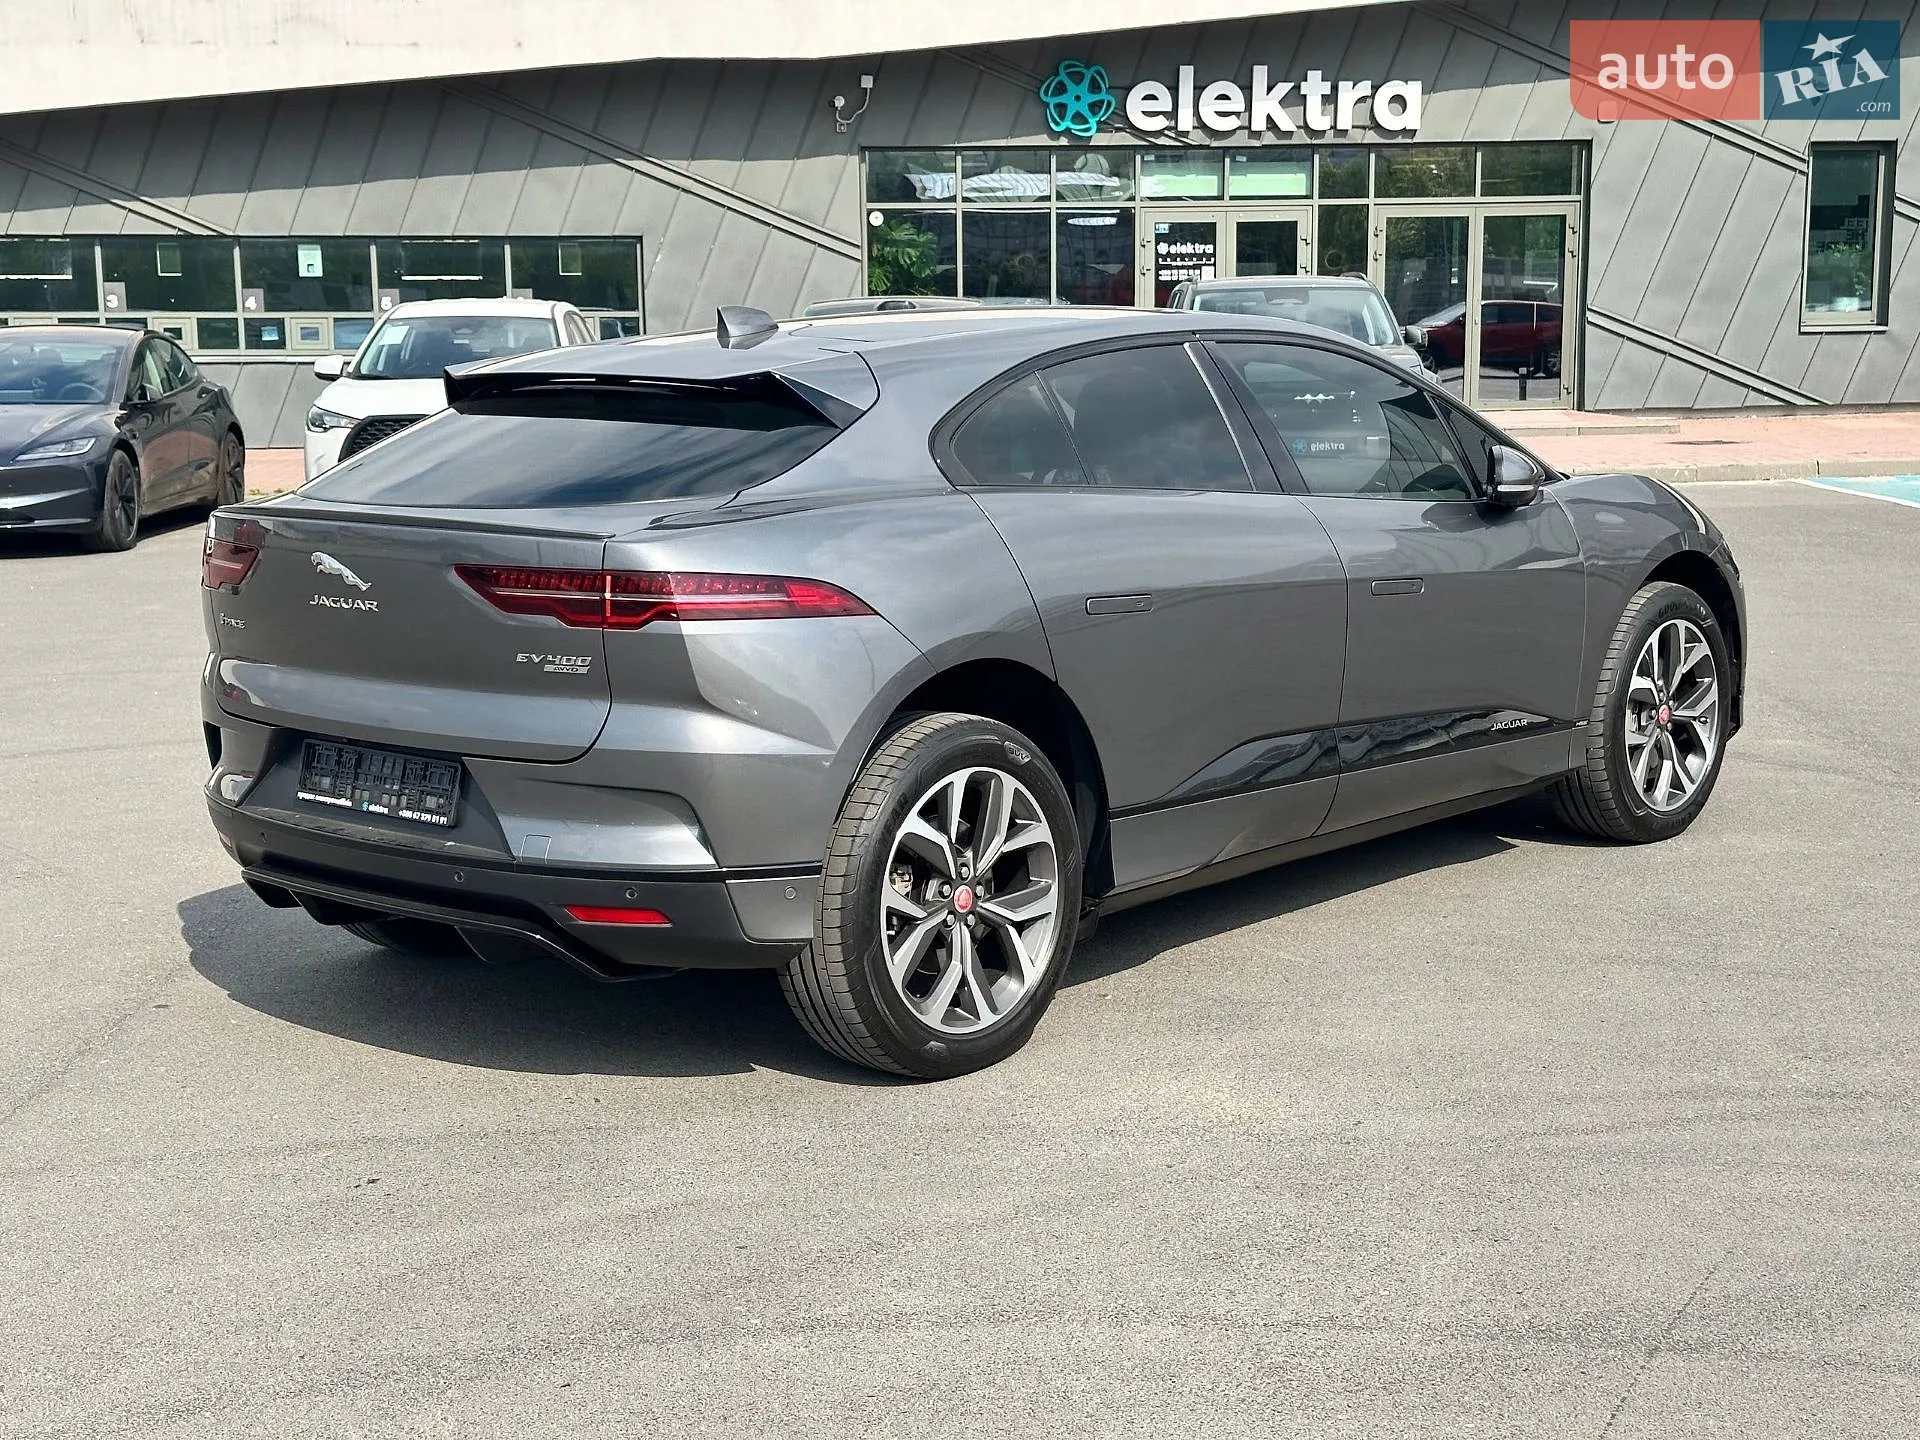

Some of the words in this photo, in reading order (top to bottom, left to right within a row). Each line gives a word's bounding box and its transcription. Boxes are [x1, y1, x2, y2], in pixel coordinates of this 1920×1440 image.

[1125, 65, 1422, 132] elektra
[1169, 242, 1213, 254] elektra
[106, 294, 119, 309] 3
[244, 296, 257, 310] 4
[1310, 441, 1345, 451] elektra
[309, 594, 379, 612] JAGUAR
[1490, 719, 1528, 731] JAGUAR
